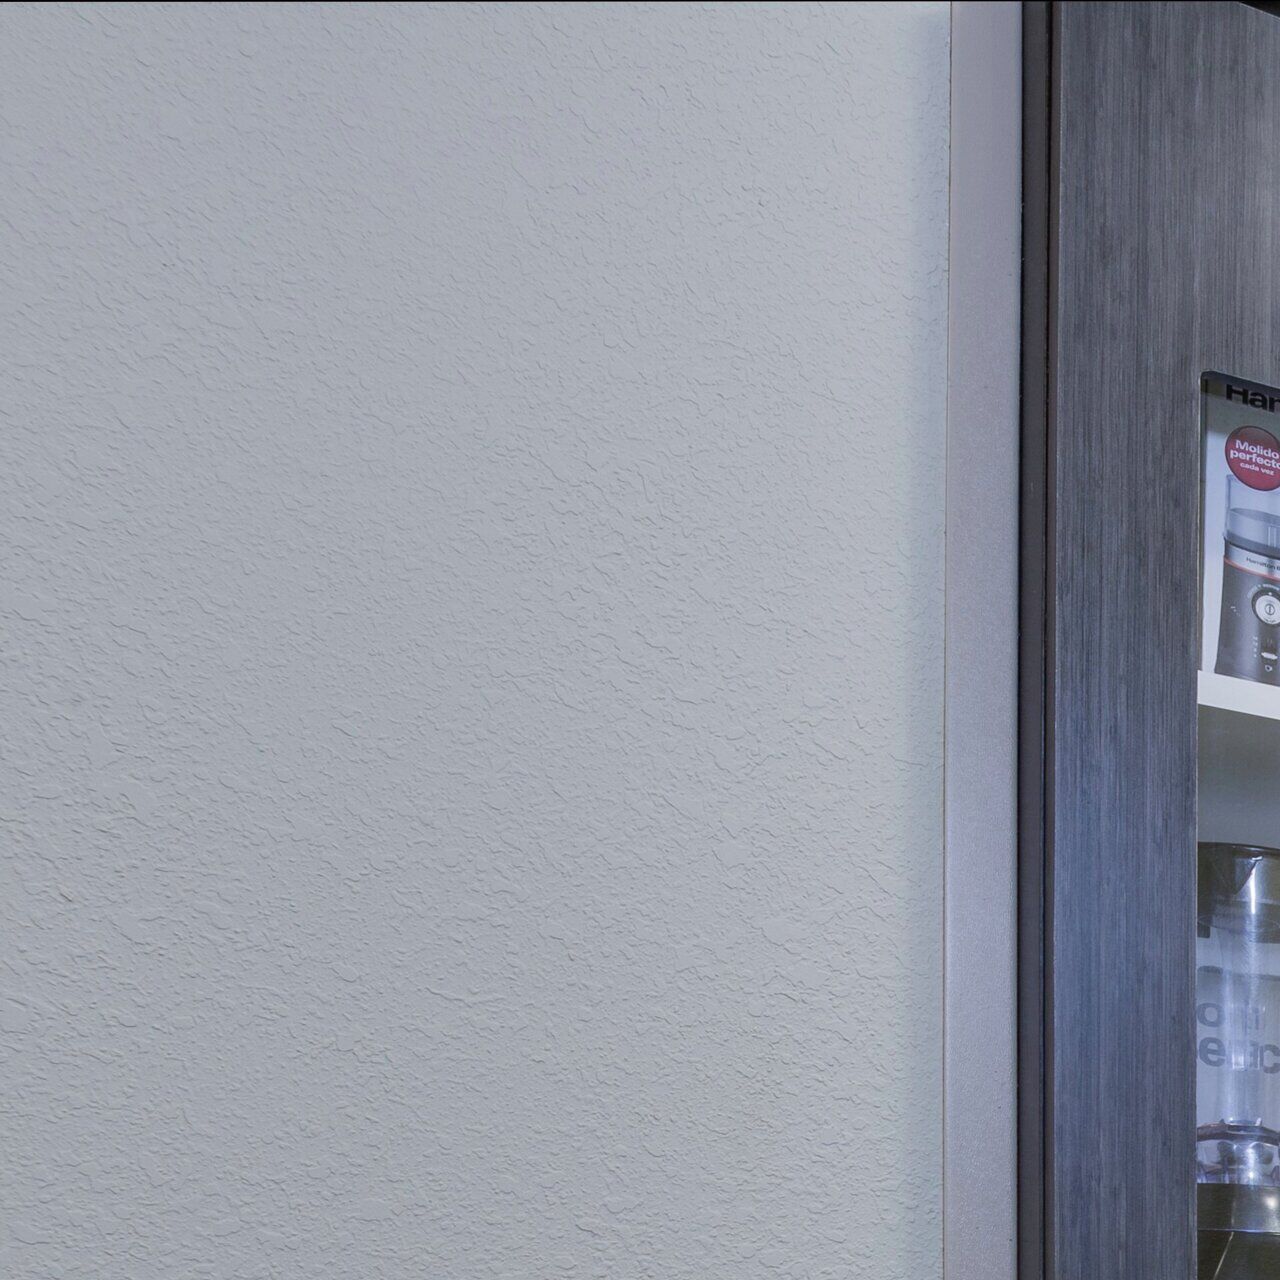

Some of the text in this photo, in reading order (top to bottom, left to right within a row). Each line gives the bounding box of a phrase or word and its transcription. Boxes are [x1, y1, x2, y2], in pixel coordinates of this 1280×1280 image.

[1235, 439, 1280, 459] Molido
[1240, 462, 1275, 476] cada vez
